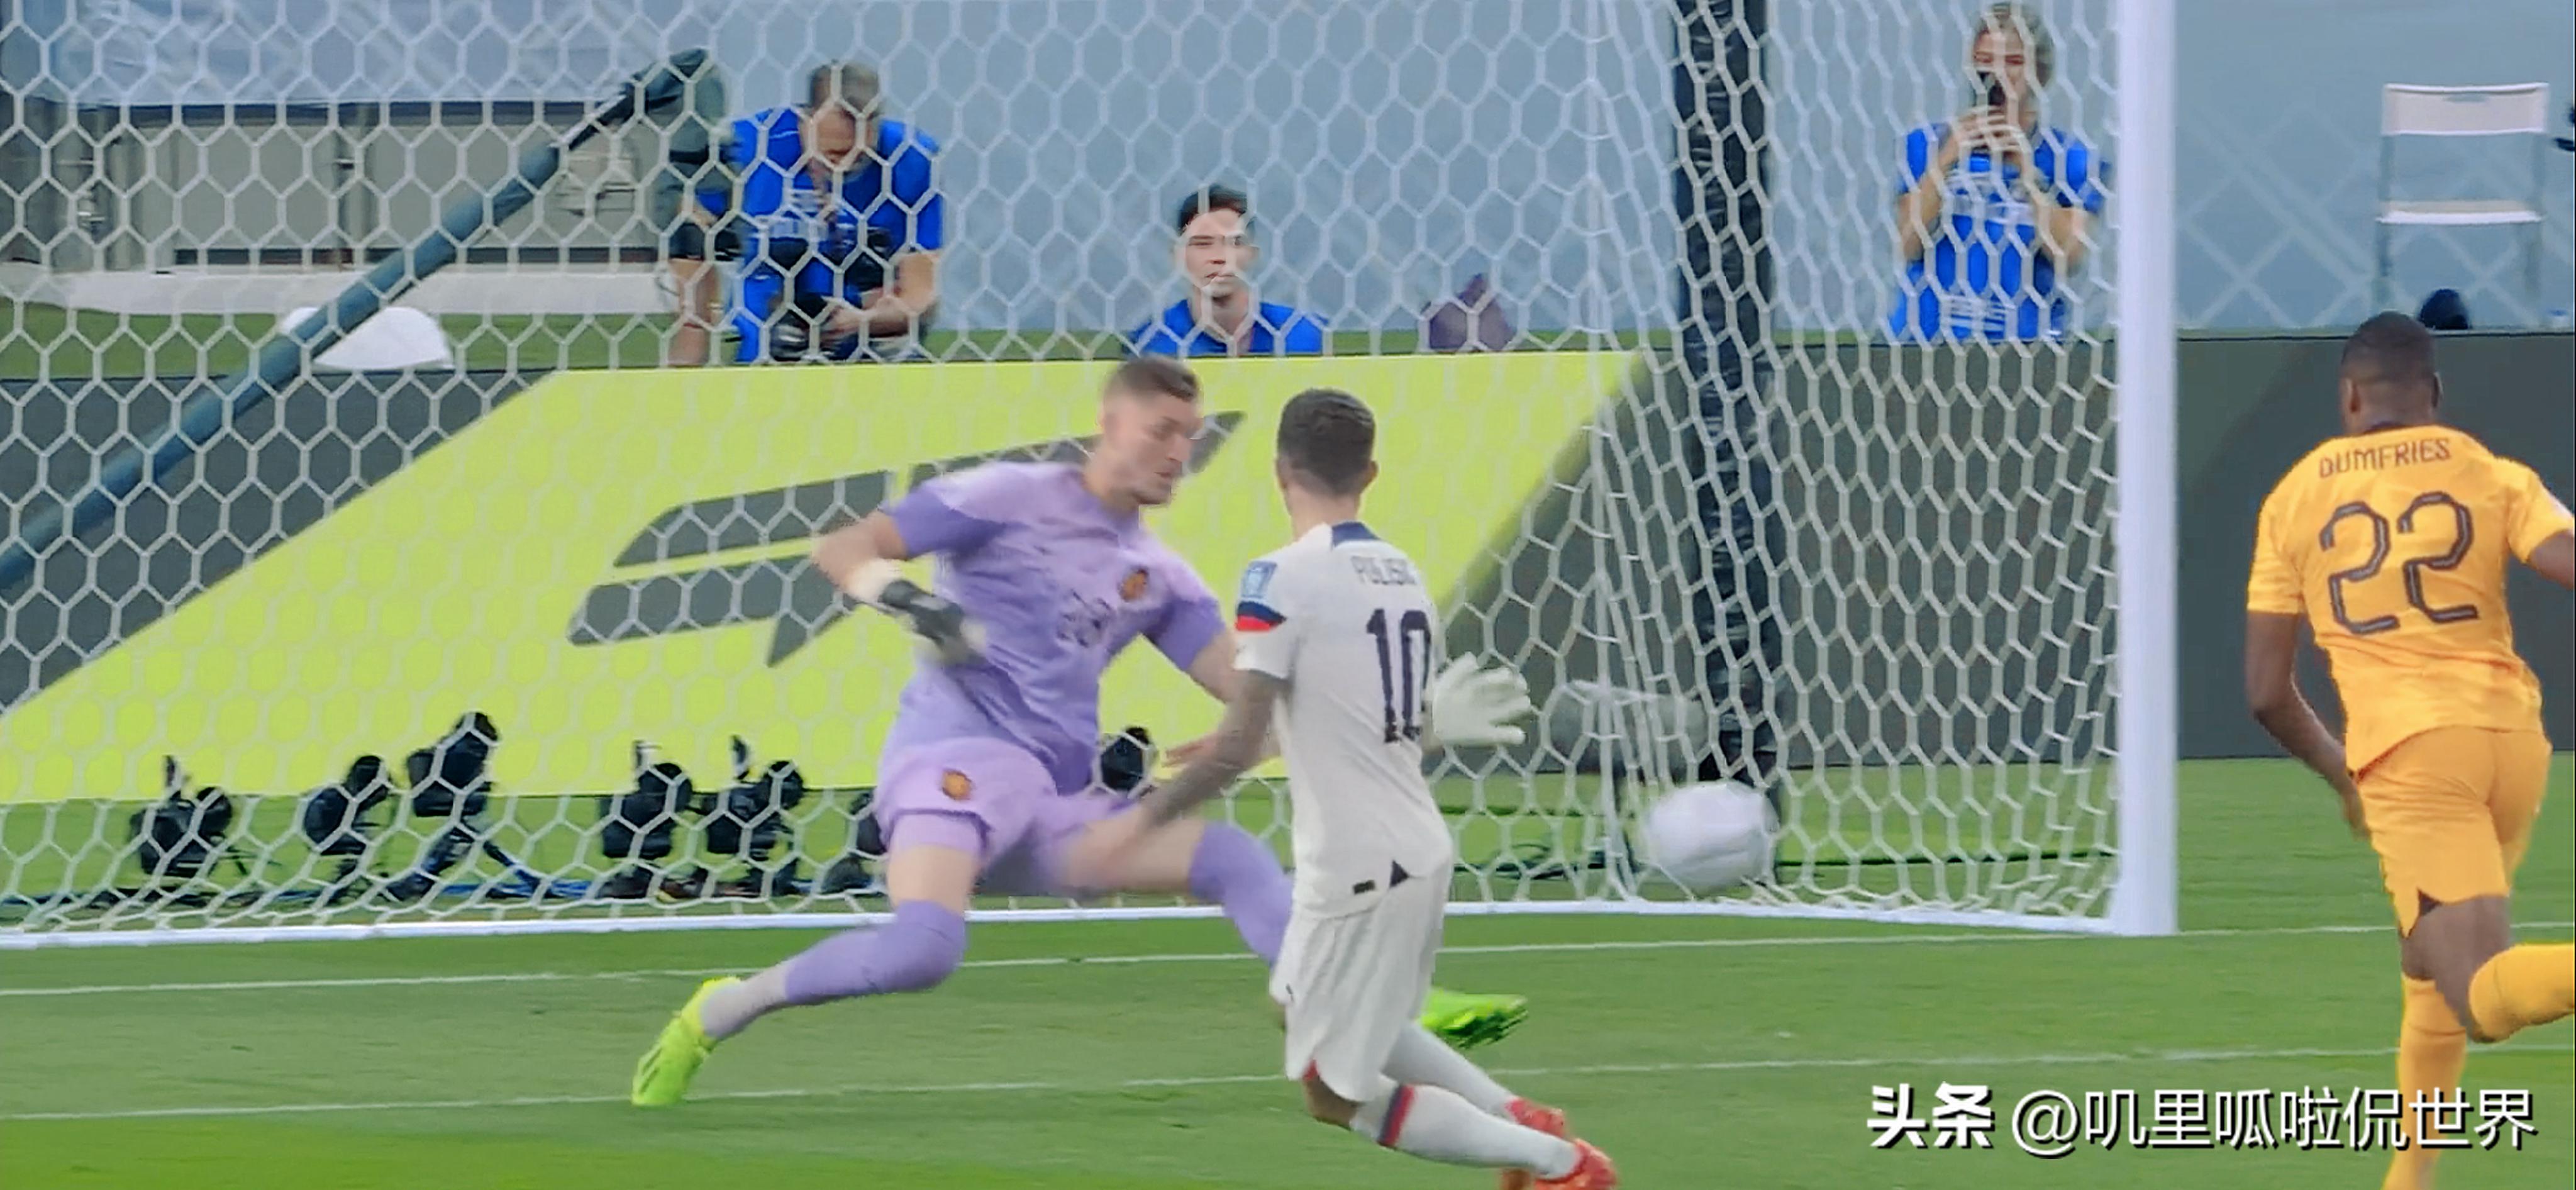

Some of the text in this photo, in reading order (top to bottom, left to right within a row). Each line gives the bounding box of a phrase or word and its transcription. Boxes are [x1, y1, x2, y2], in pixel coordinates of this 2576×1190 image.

[2319, 438, 2451, 478] DUMFRIES
[2319, 491, 2479, 635] 22
[1366, 608, 1431, 743] 10
